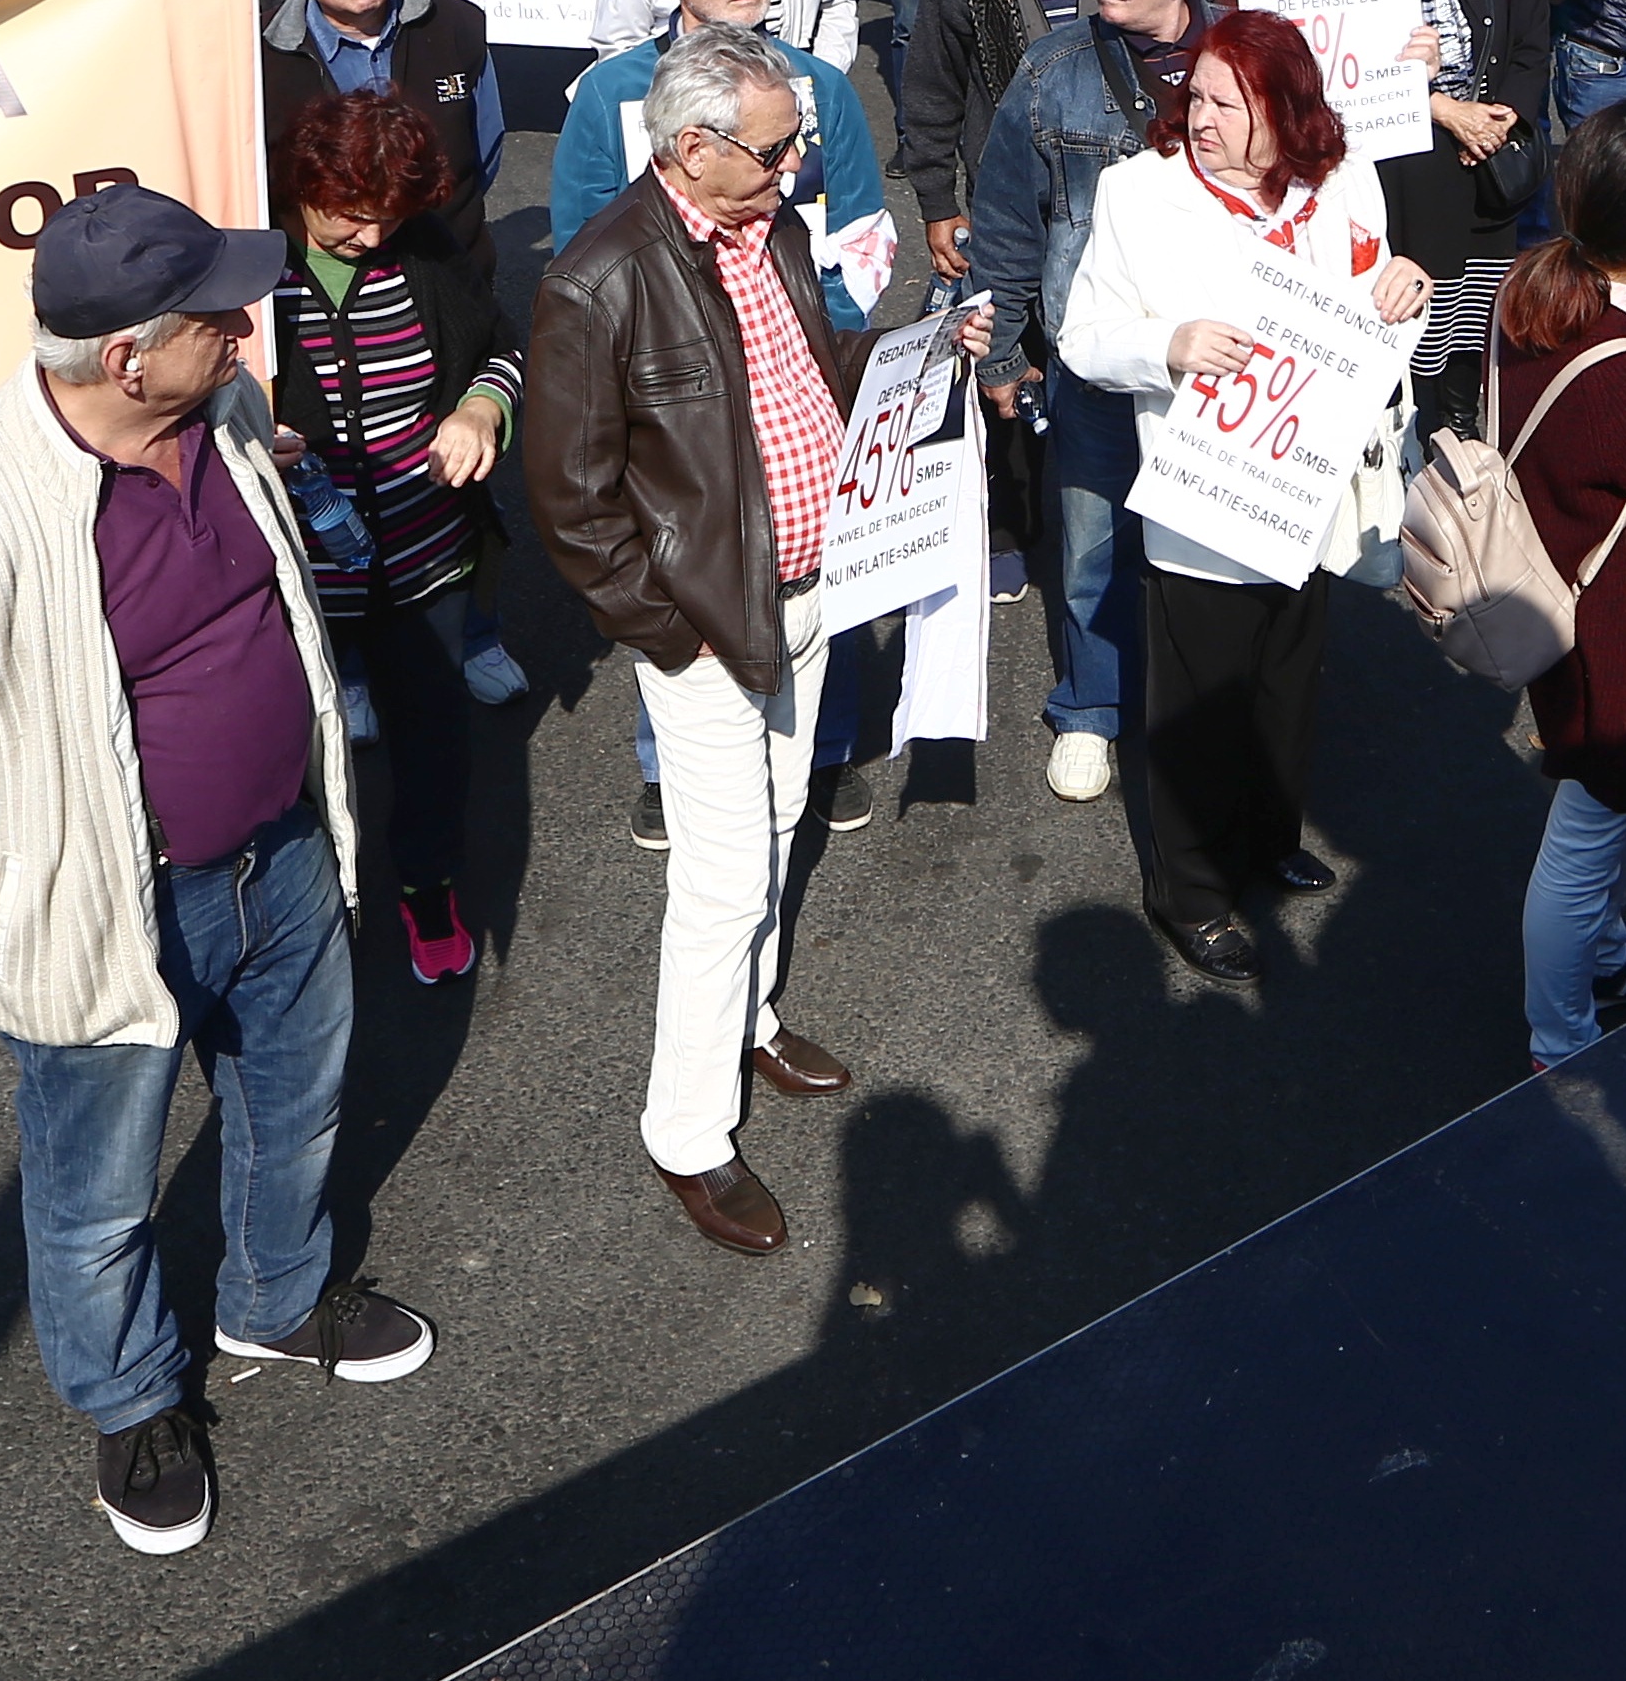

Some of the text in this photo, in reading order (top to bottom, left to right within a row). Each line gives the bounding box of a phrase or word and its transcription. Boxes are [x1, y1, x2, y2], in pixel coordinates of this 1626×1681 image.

[493, 0, 513, 18] de
[518, 1, 550, 21] lux.
[1361, 88, 1413, 106] DECENT
[1364, 64, 1413, 83] SMB=
[1250, 260, 1400, 350] REDATI-NE PUNCTUL
[875, 334, 931, 367] REDATI-NE
[1256, 315, 1360, 379] DE PENSIE DE
[877, 387, 893, 406] DE
[1190, 342, 1318, 461] 45%
[836, 402, 915, 517] 45%
[915, 461, 953, 485] SMB=
[1177, 428, 1214, 457] NIVEL
[1217, 449, 1237, 467] DE
[1240, 460, 1270, 486] TRAI
[1271, 474, 1323, 510] DECENT
[1291, 445, 1338, 477] SMB=
[836, 525, 867, 548] NIVEL
[868, 518, 882, 534] DE
[884, 508, 907, 528] TRAI
[908, 494, 949, 520] DECENT
[1150, 455, 1314, 546] NU INFLATIE=SARACIE
[825, 526, 950, 590] NU INFLATIE=SARACIE
